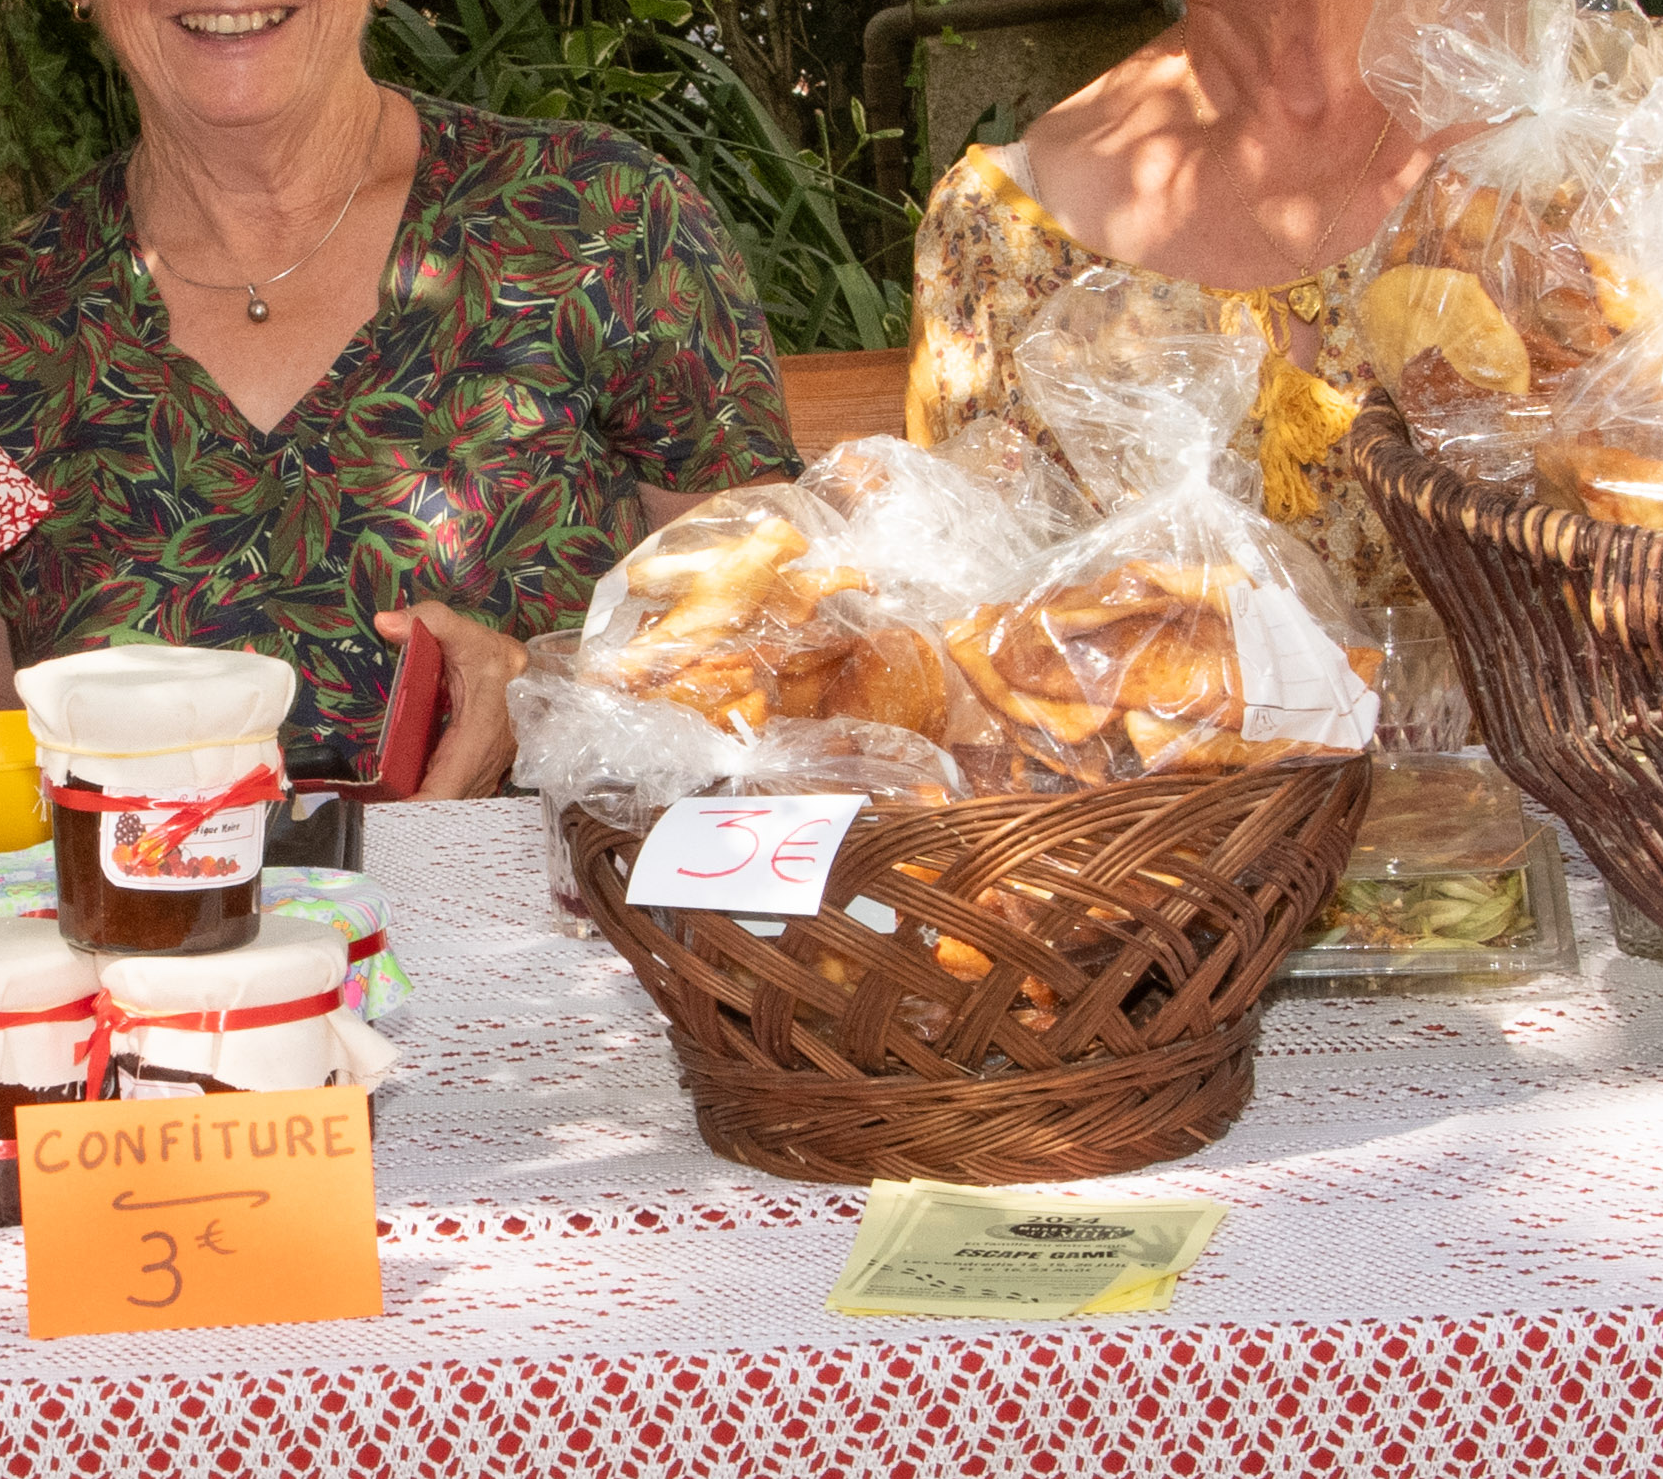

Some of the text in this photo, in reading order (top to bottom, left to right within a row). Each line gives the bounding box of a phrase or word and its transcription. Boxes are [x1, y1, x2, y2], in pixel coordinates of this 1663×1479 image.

[677, 810, 832, 883] 3€
[34, 1113, 355, 1174] CONFITURE
[1026, 1216, 1102, 1224] 2024
[126, 1219, 237, 1309] 3€
[954, 1248, 1120, 1260] ESCAPE GAME
